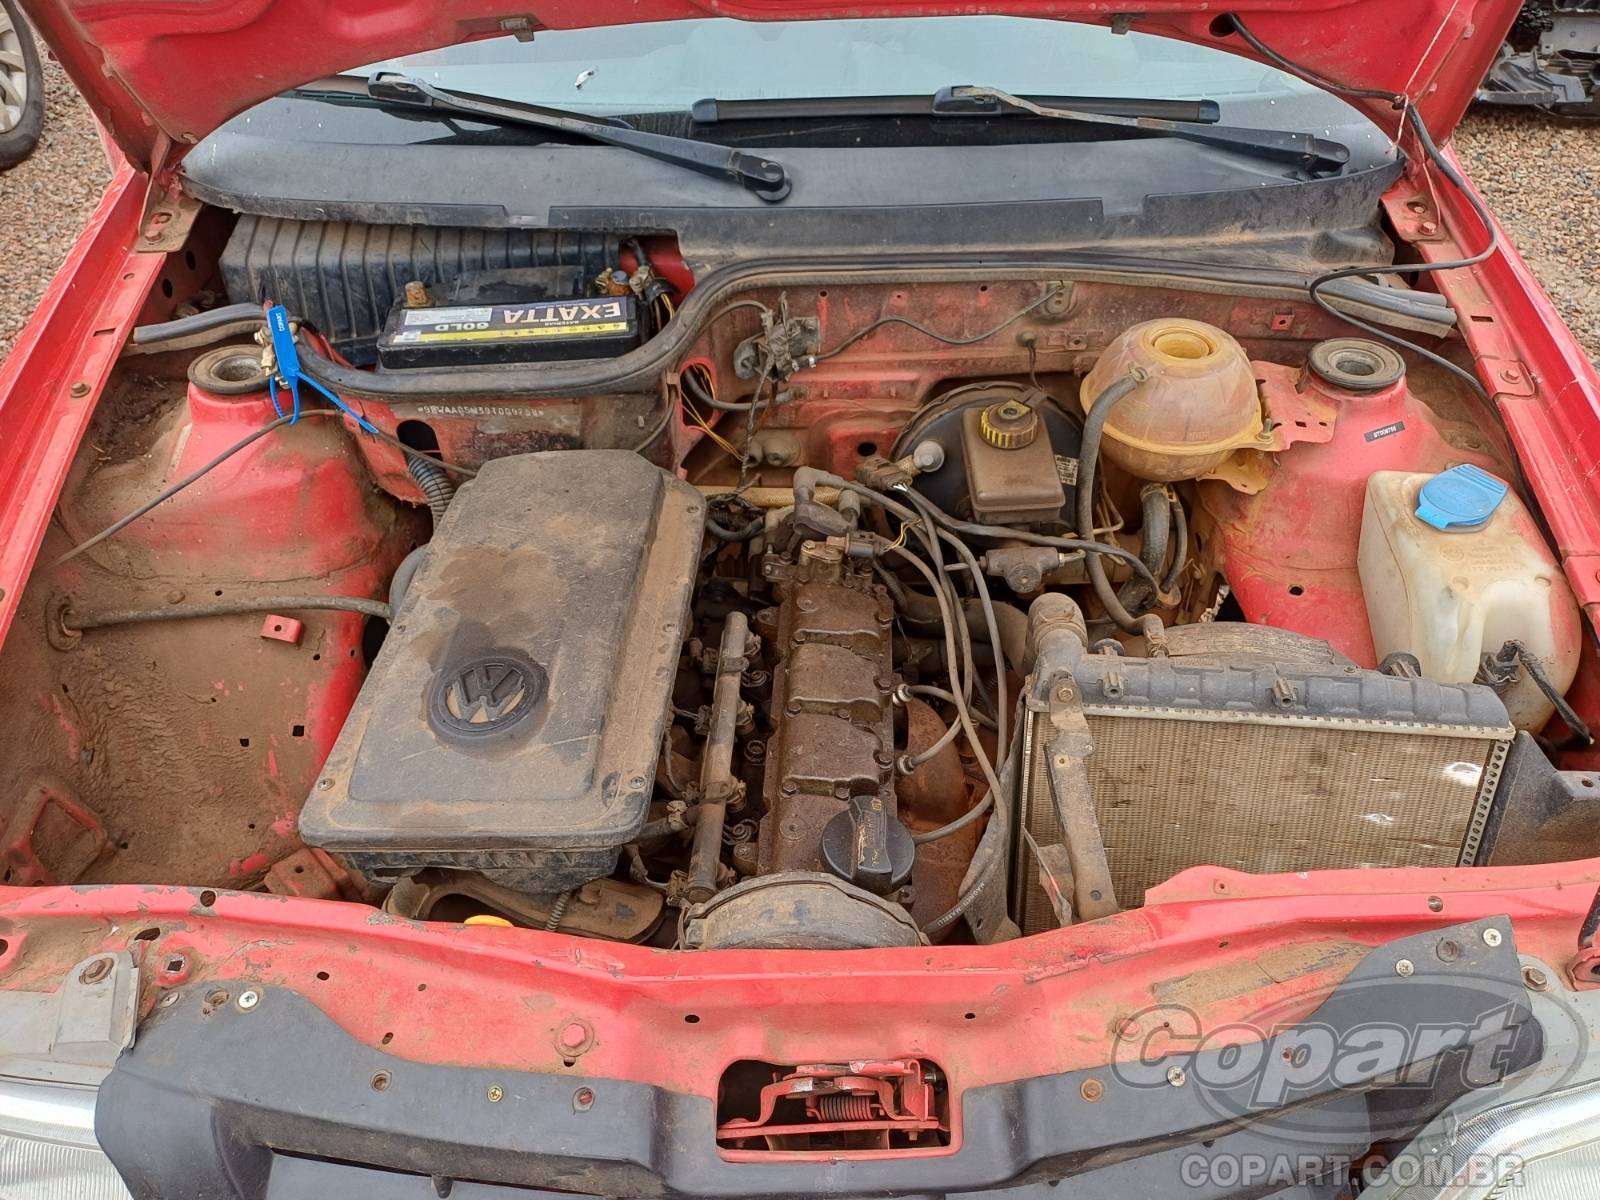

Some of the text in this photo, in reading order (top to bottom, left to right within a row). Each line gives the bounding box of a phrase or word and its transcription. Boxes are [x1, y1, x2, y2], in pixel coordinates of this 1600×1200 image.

[503, 301, 621, 324] EXATTA
[434, 321, 490, 332] GOLD
[441, 660, 530, 728] VW
